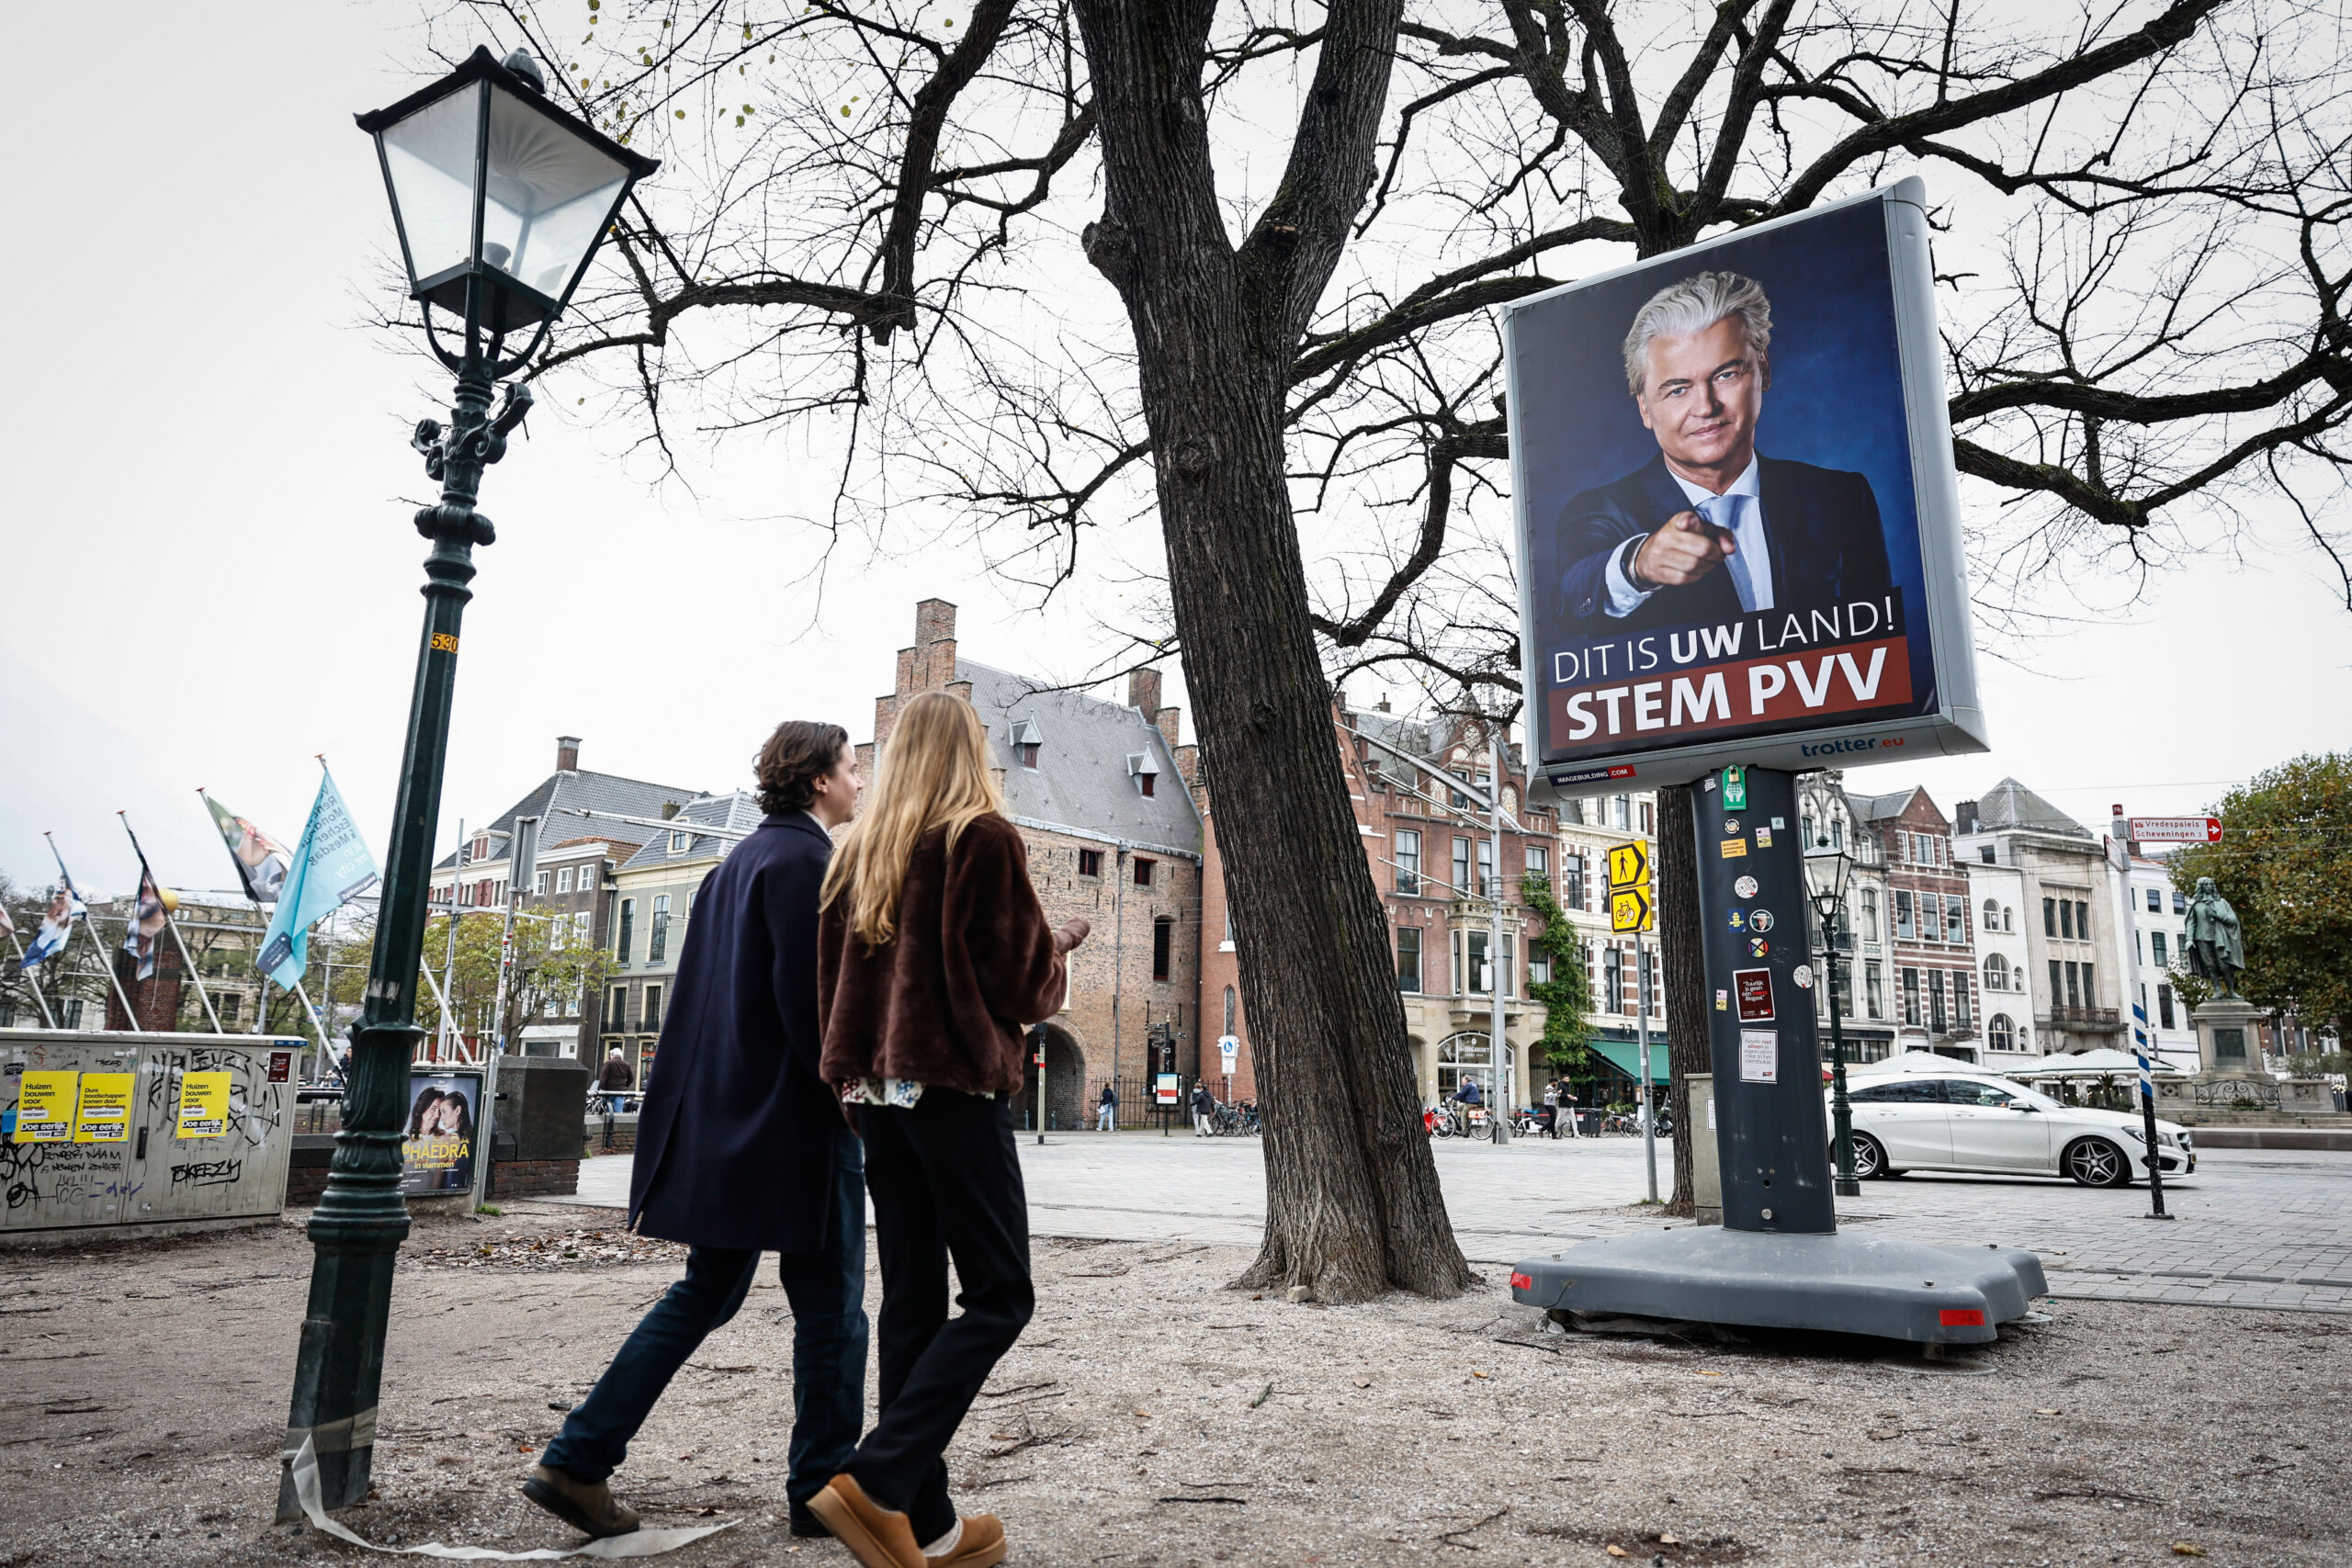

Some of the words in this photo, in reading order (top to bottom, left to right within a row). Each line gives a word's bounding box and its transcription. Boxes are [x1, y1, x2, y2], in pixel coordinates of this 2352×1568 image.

[432, 634, 458, 652] 530
[1555, 643, 1615, 682] DIT
[1628, 637, 1658, 671] IS
[1669, 623, 1744, 664] UW
[1758, 595, 1895, 650] LAND!
[1566, 671, 1732, 740] STEM
[1748, 647, 1887, 715] PVV
[2135, 830, 2195, 839] Scheveningen
[21, 1122, 39, 1131] Doe
[401, 1143, 469, 1159] PHAEDRA
[423, 1160, 455, 1169] vlammen
